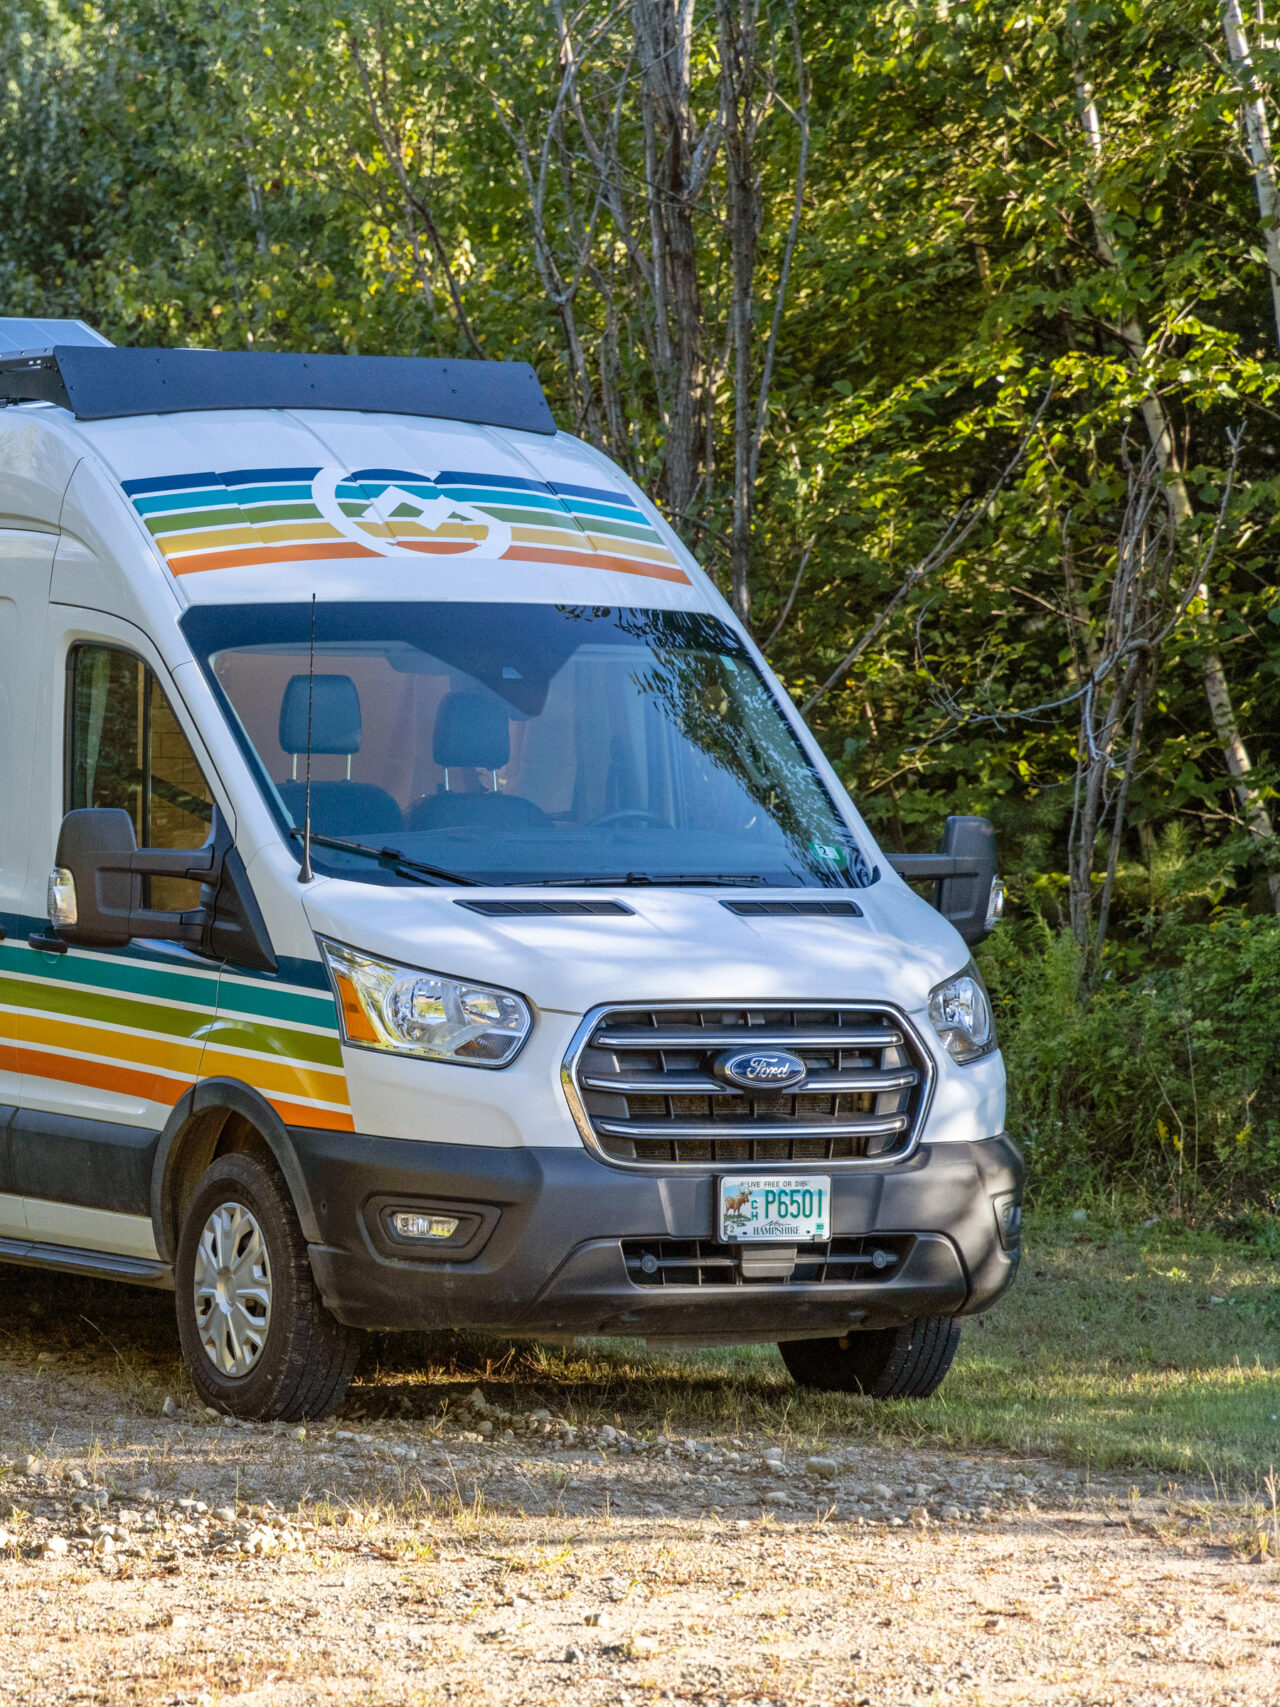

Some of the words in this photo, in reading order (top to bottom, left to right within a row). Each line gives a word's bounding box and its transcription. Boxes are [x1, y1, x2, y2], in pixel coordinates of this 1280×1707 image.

[747, 1057, 789, 1078] Ford
[765, 1189, 822, 1219] P6501
[753, 1226, 800, 1236] HAMPSHIRE
